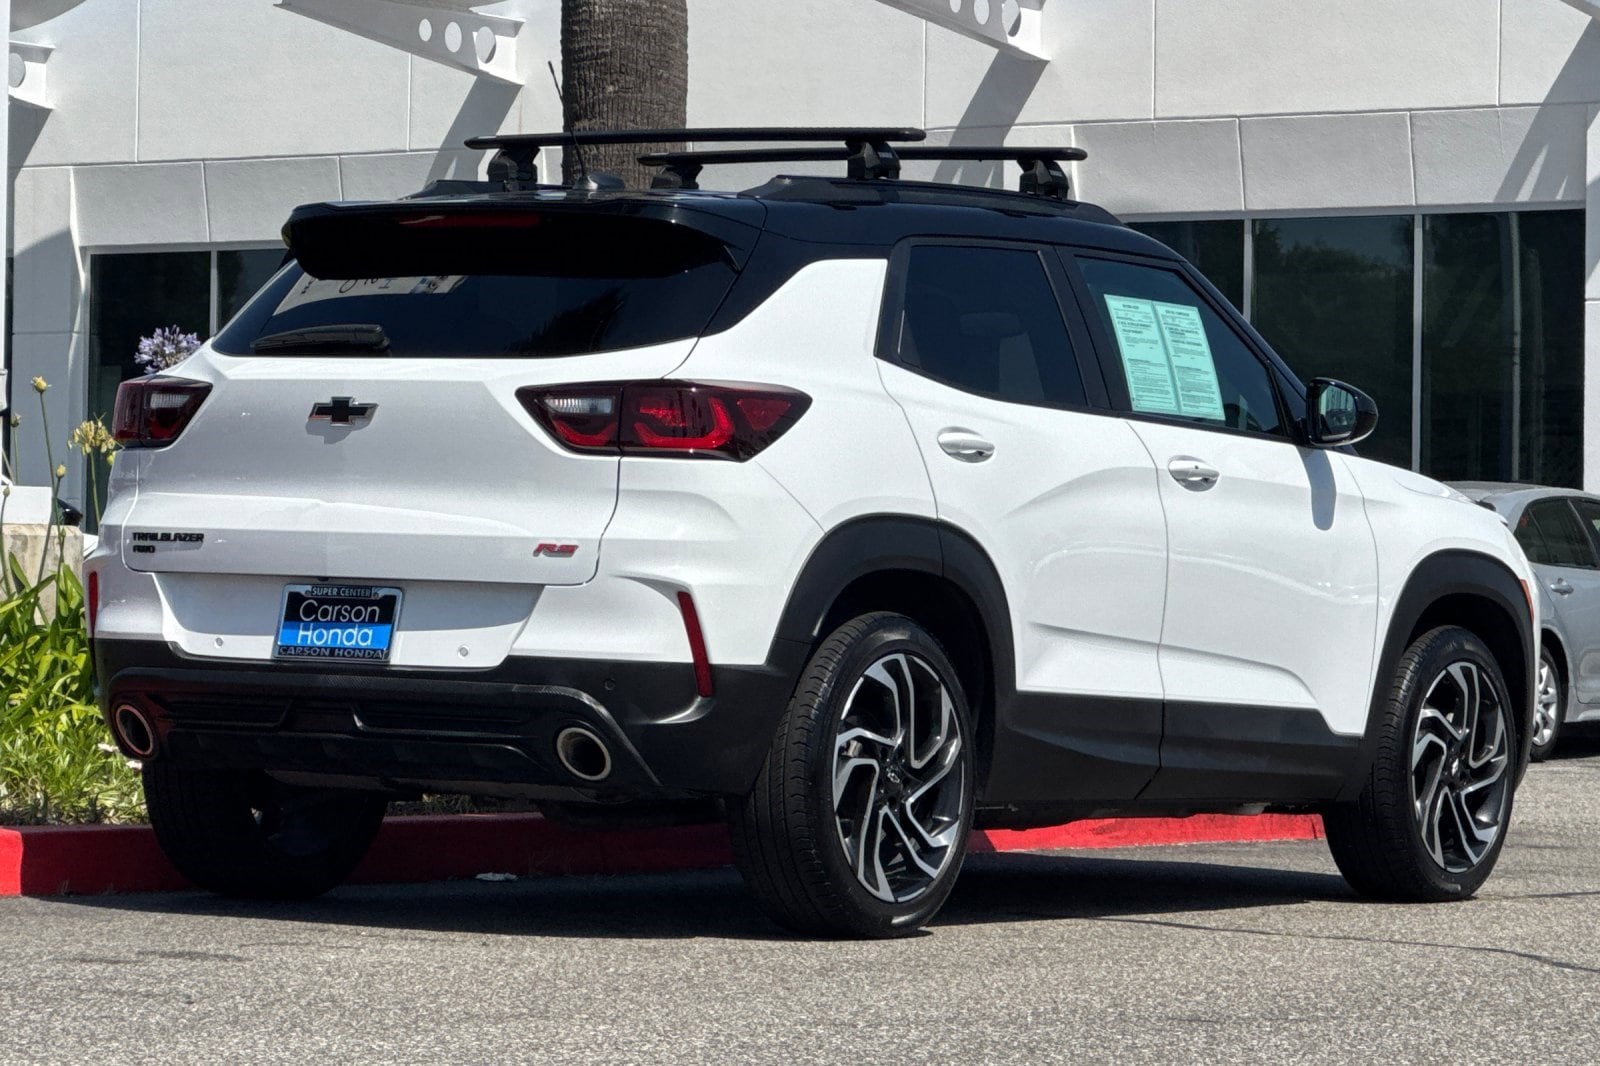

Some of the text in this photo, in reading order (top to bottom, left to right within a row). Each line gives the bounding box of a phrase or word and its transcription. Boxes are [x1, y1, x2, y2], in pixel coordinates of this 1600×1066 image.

[534, 543, 578, 556] RS
[312, 587, 371, 597] SUPER CENTER
[300, 599, 379, 622] Carson
[297, 623, 373, 645] Honda
[280, 646, 383, 658] CARSON HONDA
